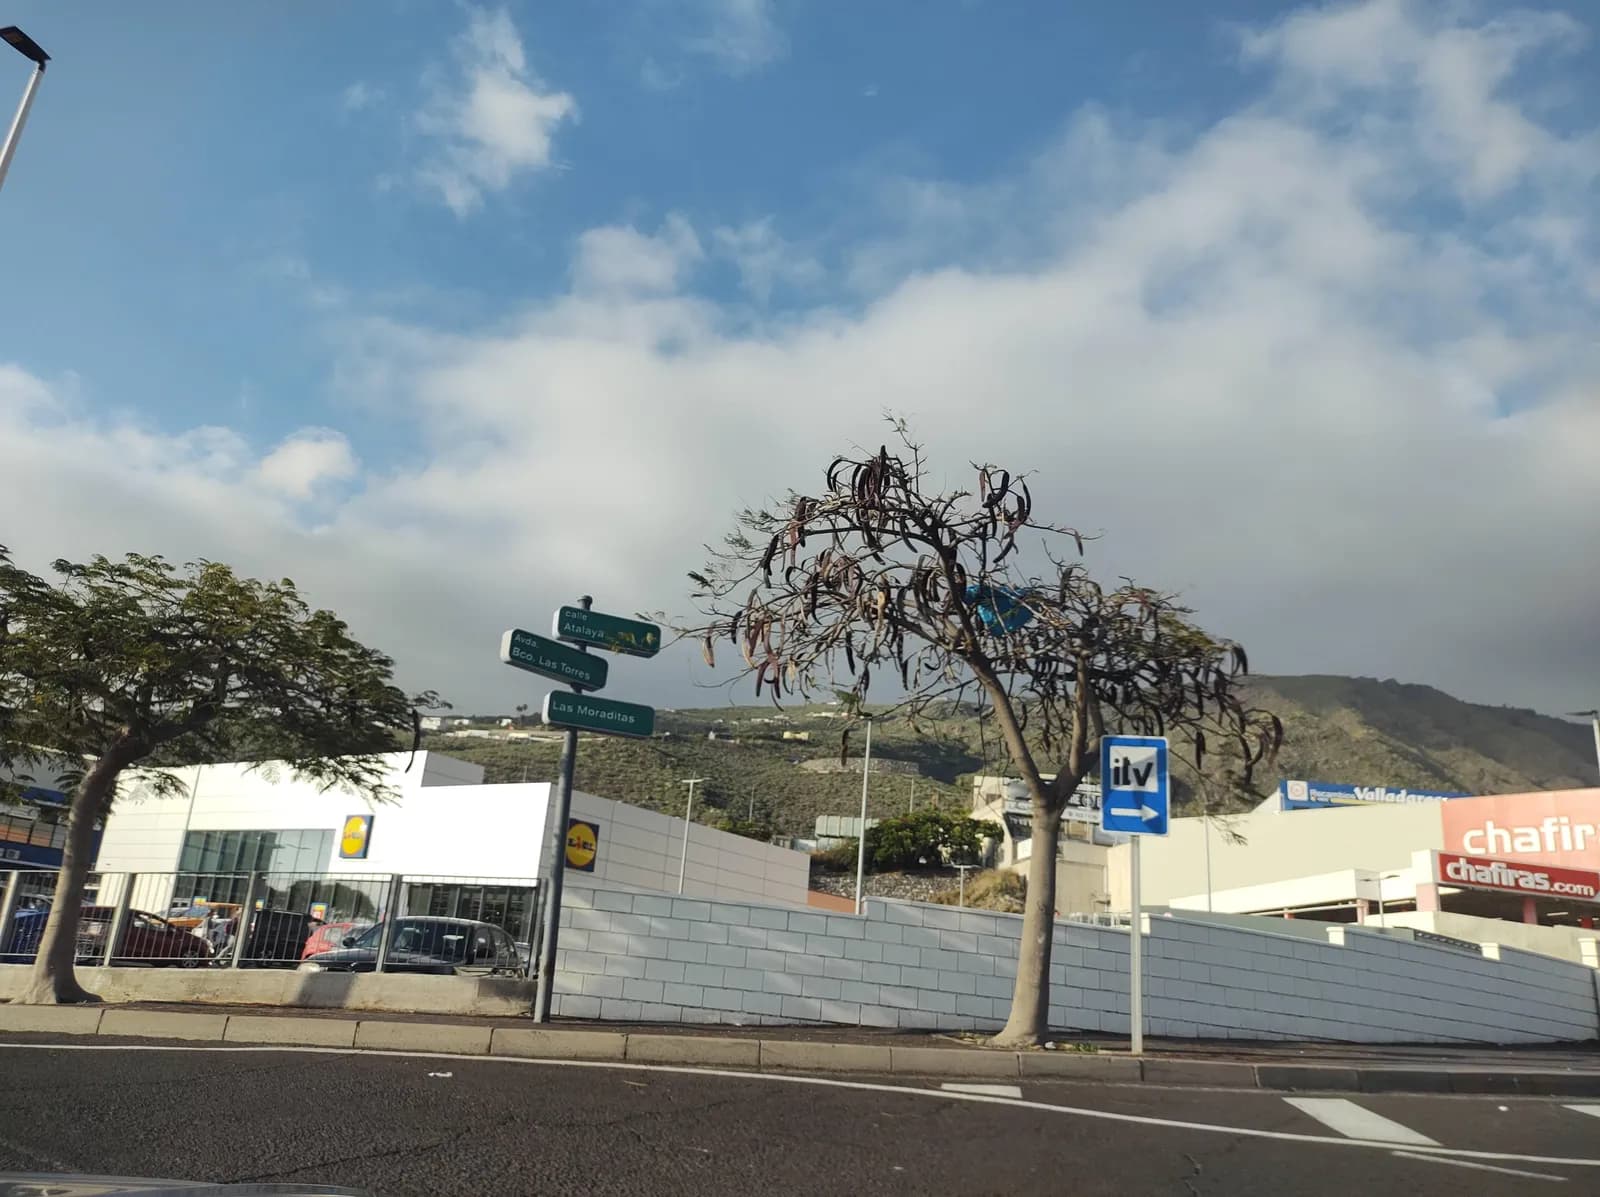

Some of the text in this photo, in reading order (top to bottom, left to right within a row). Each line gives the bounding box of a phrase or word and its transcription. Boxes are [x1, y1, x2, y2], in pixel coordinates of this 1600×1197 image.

[514, 633, 539, 649] Avda.
[563, 622, 604, 640] Atalaya
[538, 656, 557, 669] Las
[560, 662, 591, 681] Torres
[552, 700, 635, 724] Las Moraditas
[1353, 786, 1448, 804] Valladar
[1462, 815, 1600, 855] chafir
[1446, 857, 1595, 897] chafiras.com
